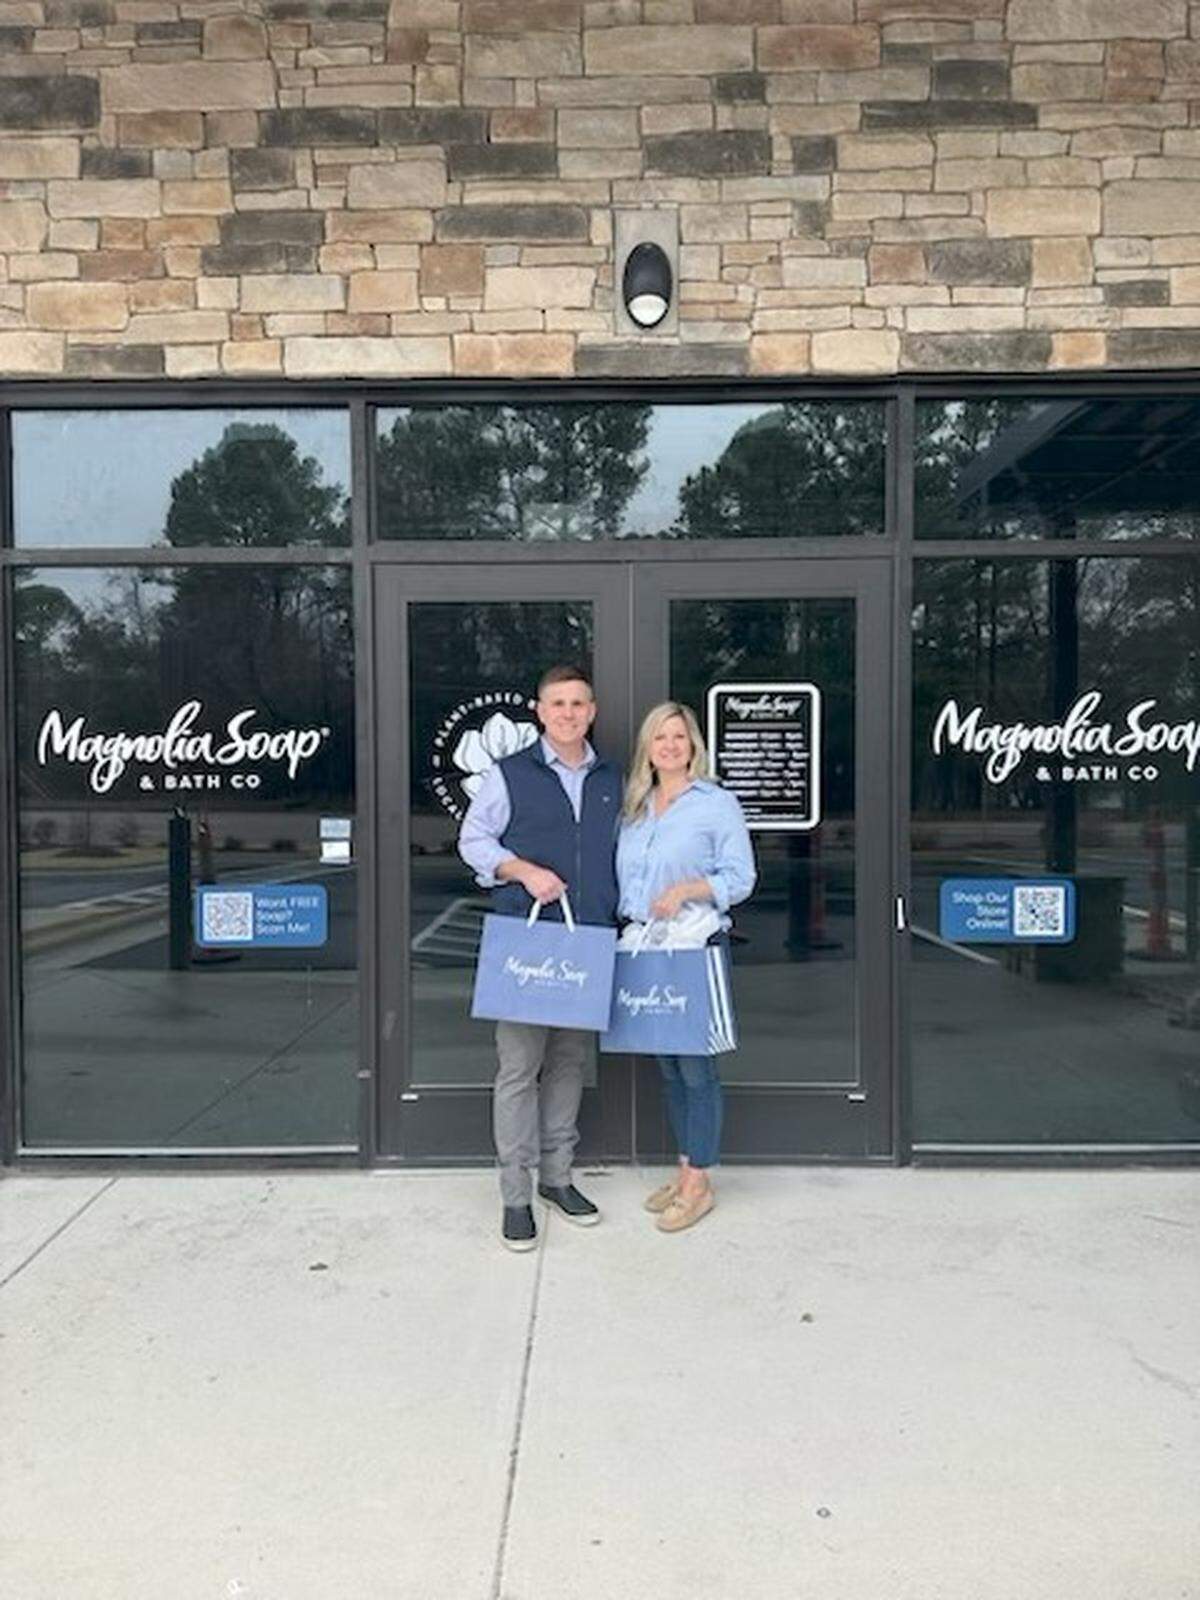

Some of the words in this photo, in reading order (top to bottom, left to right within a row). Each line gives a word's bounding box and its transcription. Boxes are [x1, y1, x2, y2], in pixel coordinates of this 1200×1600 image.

[434, 692, 523, 747] PLANT-BASED
[933, 690, 1114, 783] Magnolia
[38, 700, 215, 793] Magnolia
[215, 709, 322, 780] Soap
[1036, 767, 1050, 781] &
[1062, 766, 1118, 781] BATH
[1127, 765, 1159, 781] CO
[139, 775, 155, 790] &
[164, 775, 220, 789] BATH
[230, 774, 261, 789] CO
[290, 896, 318, 909] FREE
[952, 891, 983, 906] Shop
[986, 891, 1008, 903] Our
